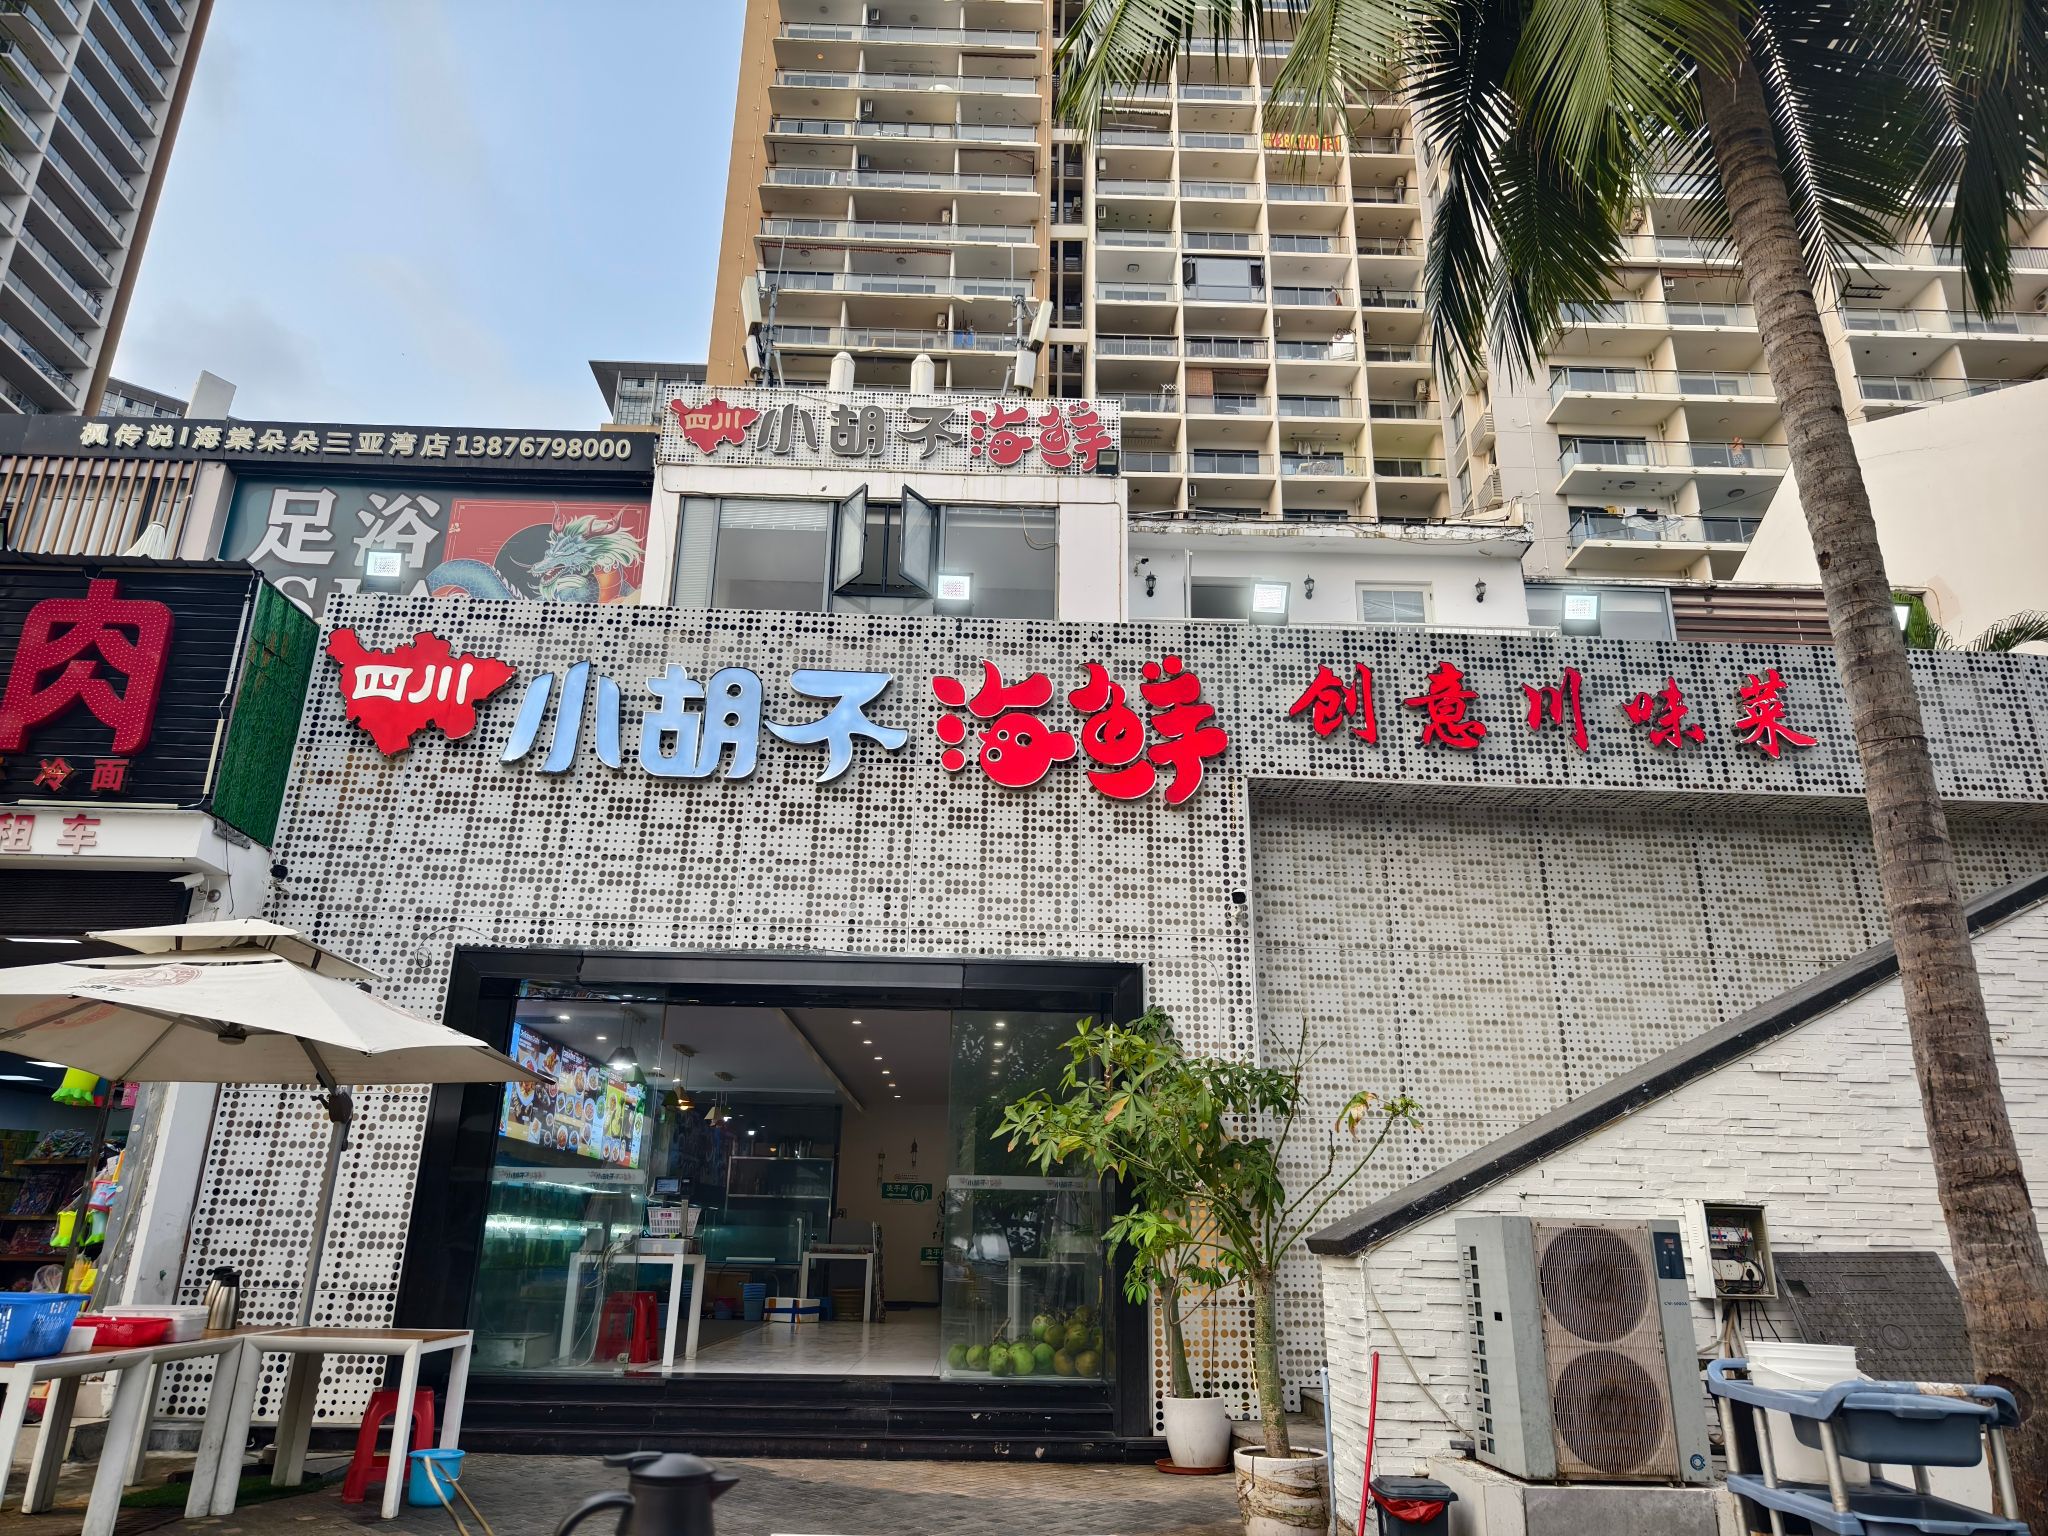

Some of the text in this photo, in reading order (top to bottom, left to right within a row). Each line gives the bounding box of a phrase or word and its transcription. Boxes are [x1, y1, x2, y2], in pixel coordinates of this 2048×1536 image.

[454, 434, 632, 460] 13876798000
[684, 402, 1114, 472] 四川 小胡子海鲜
[248, 488, 442, 569] 足浴
[0, 579, 175, 756] 肉
[351, 655, 1230, 806] 四川 小胡子海鲜
[1288, 660, 1820, 761] 创意川味菜
[0, 757, 131, 791] 冷面
